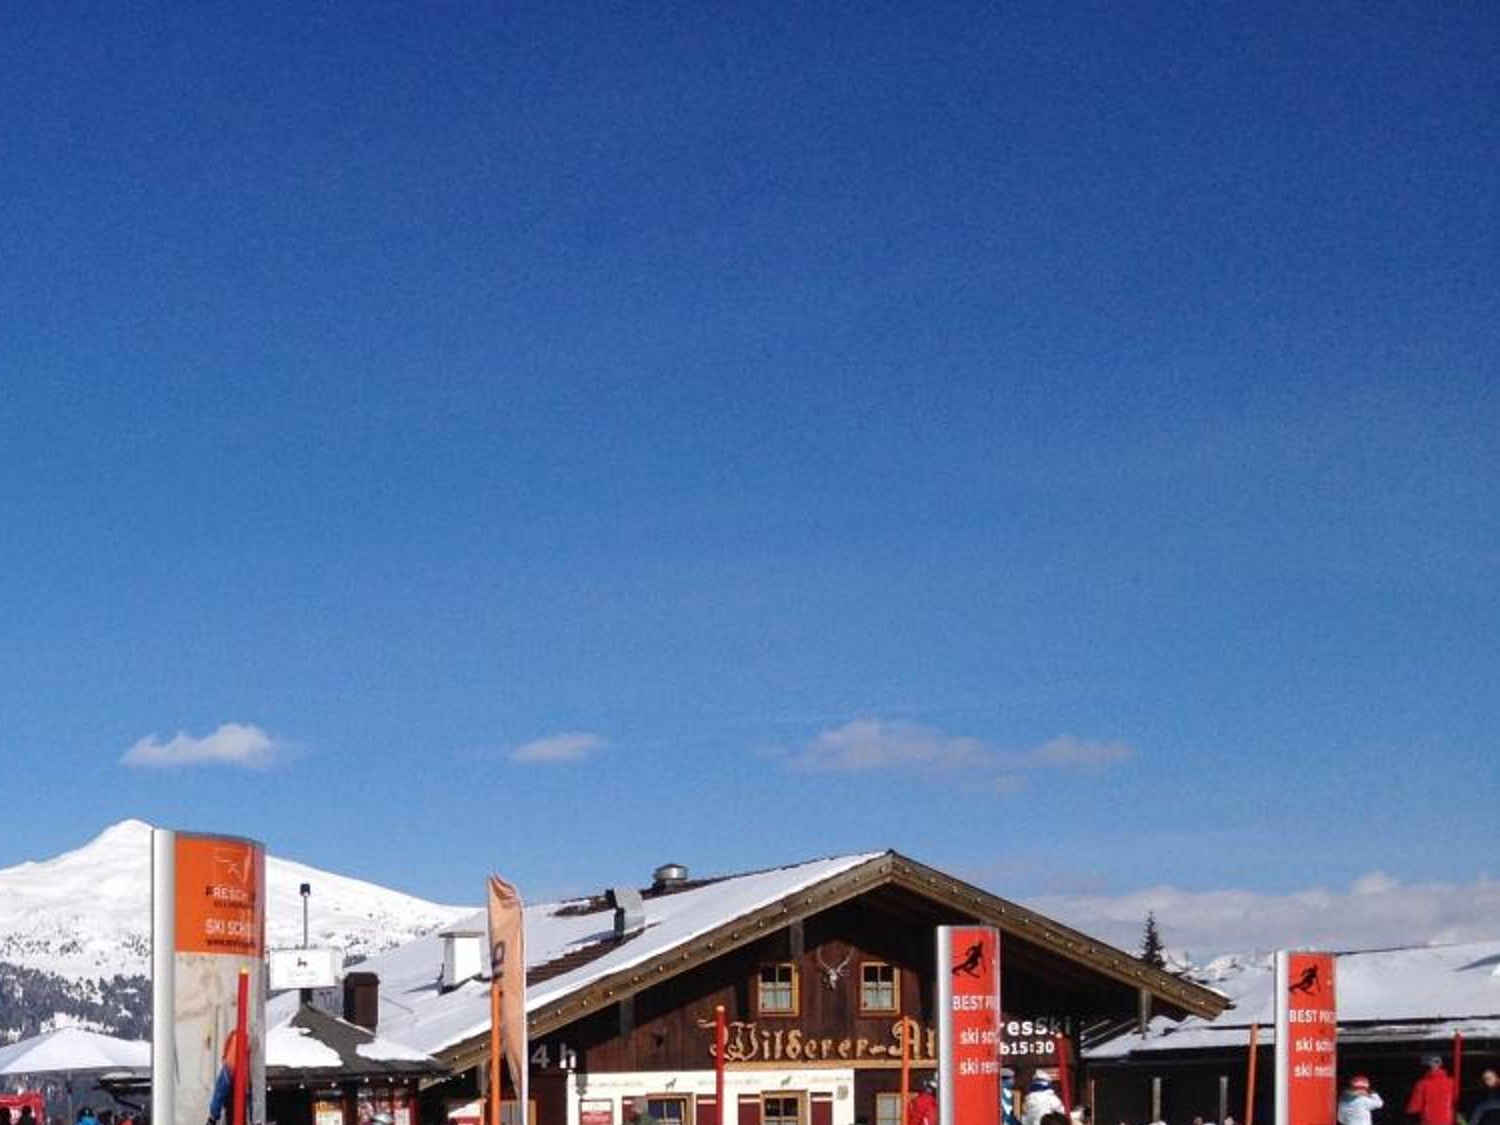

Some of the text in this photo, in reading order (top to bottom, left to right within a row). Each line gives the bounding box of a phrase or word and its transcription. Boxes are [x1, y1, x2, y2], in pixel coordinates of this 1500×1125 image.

[204, 918, 225, 935] SKI
[953, 995, 984, 1010] BEST
[1289, 1009, 1317, 1023] BEST
[697, 1019, 936, 1062] Wilderer-Al
[960, 1027, 979, 1045] ski
[1295, 1036, 1313, 1052] ski
[560, 1042, 576, 1068] h
[960, 1057, 979, 1075] ski
[1295, 1062, 1313, 1077] ski
